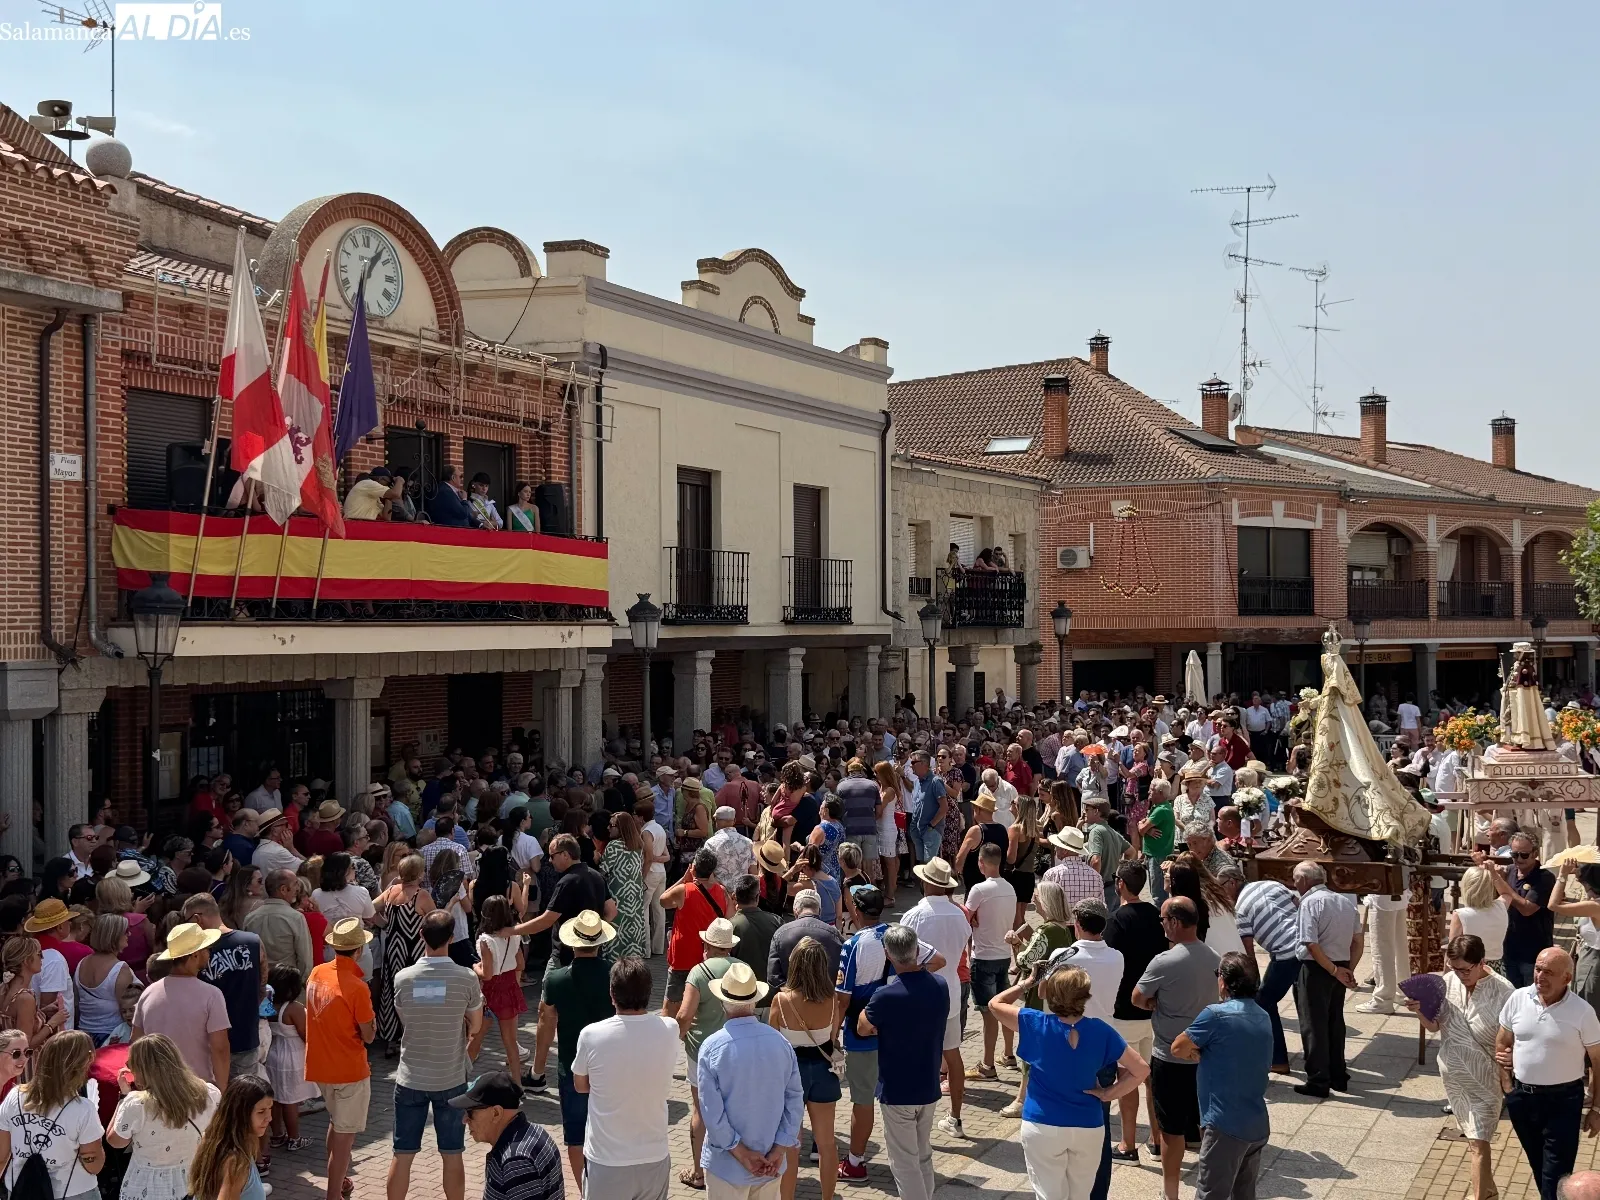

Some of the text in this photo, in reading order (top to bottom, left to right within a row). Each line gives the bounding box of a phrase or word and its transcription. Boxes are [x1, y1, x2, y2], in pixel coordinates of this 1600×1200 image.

[60, 456, 77, 465] Plaza
[53, 467, 77, 478] Mayor
[1355, 653, 1373, 662] CFE
[1377, 653, 1392, 661] BAR
